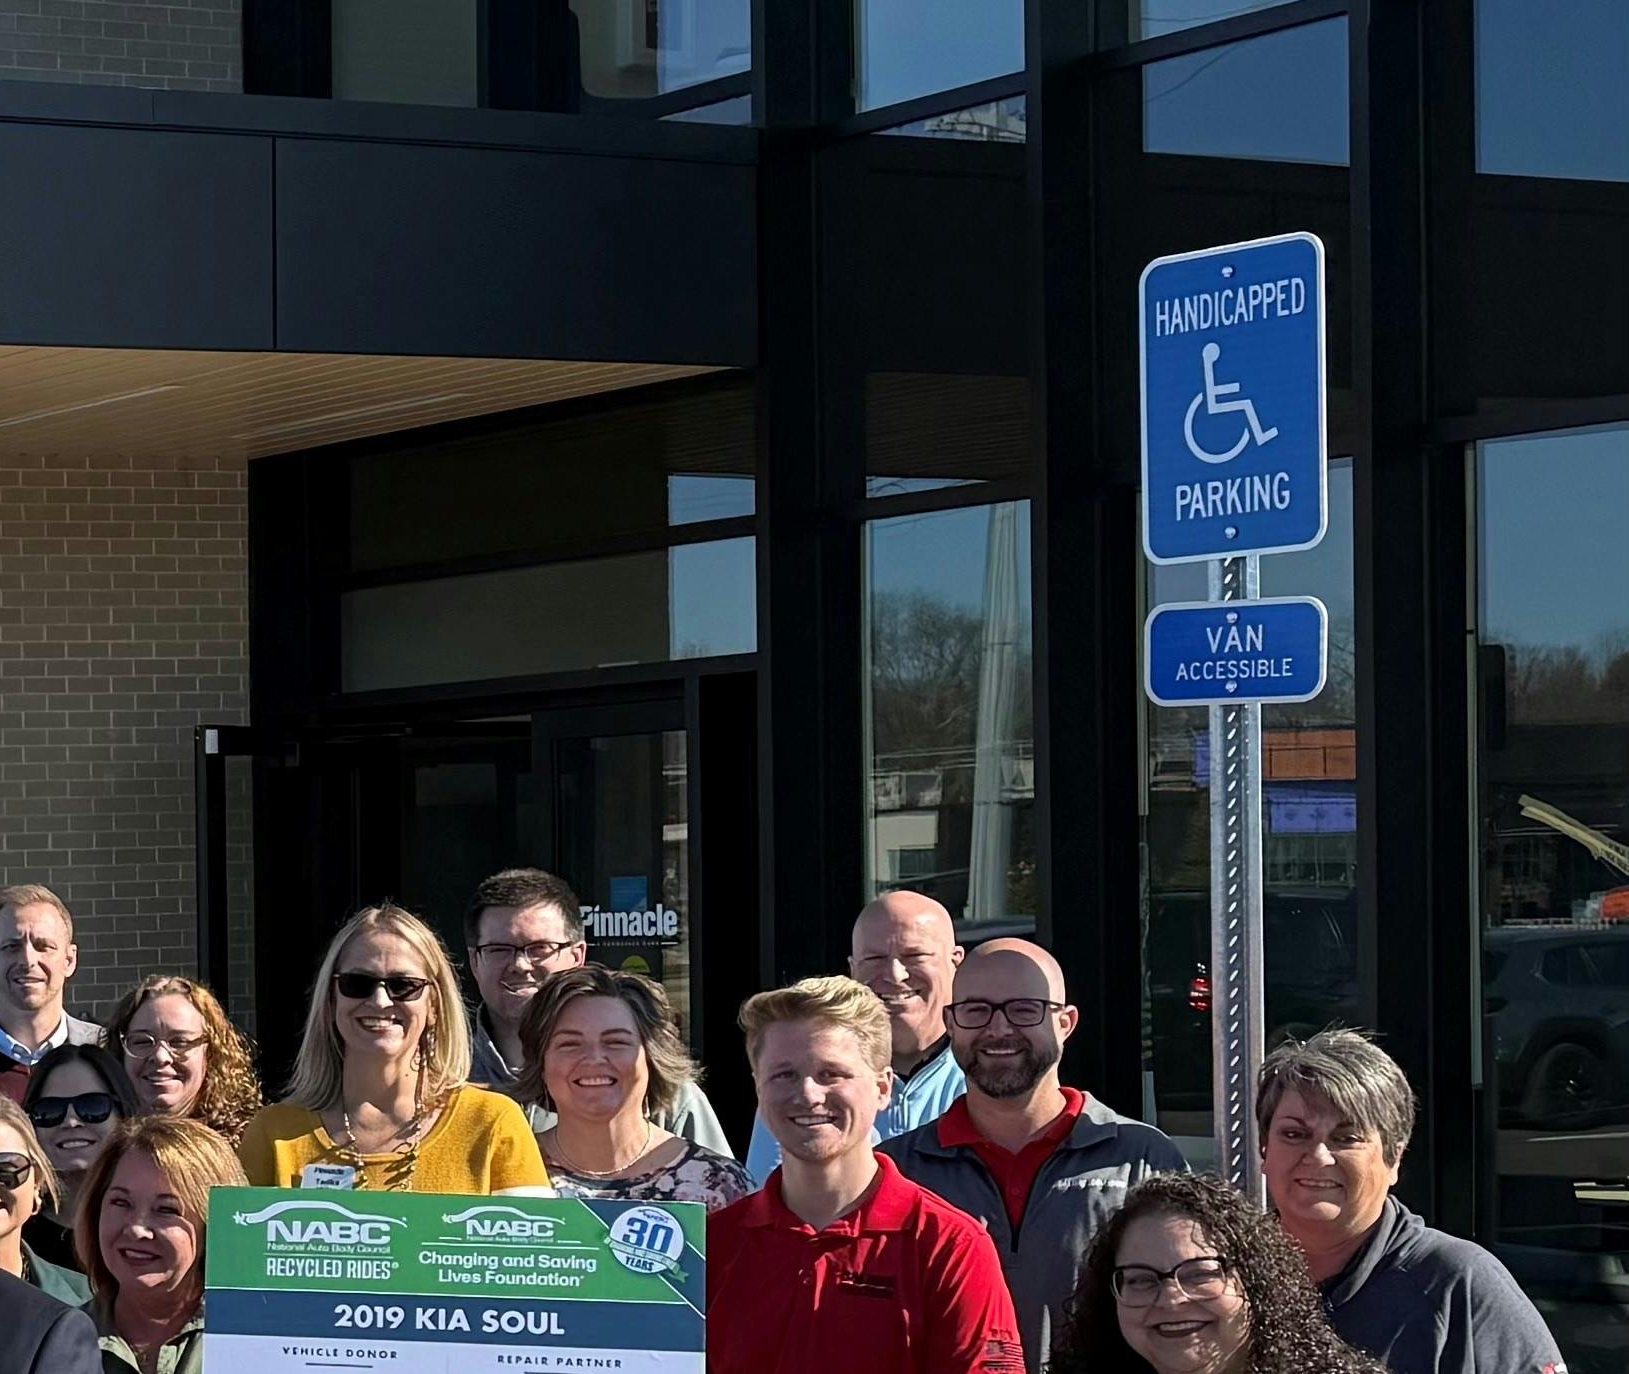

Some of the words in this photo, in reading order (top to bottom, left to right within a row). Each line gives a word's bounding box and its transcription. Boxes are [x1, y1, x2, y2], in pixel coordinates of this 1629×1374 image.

[1155, 277, 1305, 336] HANDICAPPED
[1175, 471, 1290, 522] PARKING
[1206, 624, 1263, 654] VAN
[1176, 657, 1293, 681] ACCESSIBLE
[579, 903, 678, 937] Pinnacle
[267, 1220, 391, 1245] NABC
[466, 1219, 554, 1237] NABC
[622, 1217, 674, 1254] 30
[266, 1258, 342, 1278] RECYCLED
[418, 1251, 492, 1270] Changing
[502, 1255, 533, 1267] and
[538, 1255, 597, 1272] Saving
[438, 1269, 481, 1283] Lives
[485, 1271, 580, 1287] Foundation
[334, 1304, 405, 1328] 2019
[415, 1308, 471, 1331] KIA
[482, 1310, 565, 1335] SOUL
[283, 1346, 339, 1357] VEHICLE
[346, 1349, 398, 1359] DONOR
[497, 1355, 549, 1365] REPAIR
[556, 1357, 622, 1368] PARTNER
